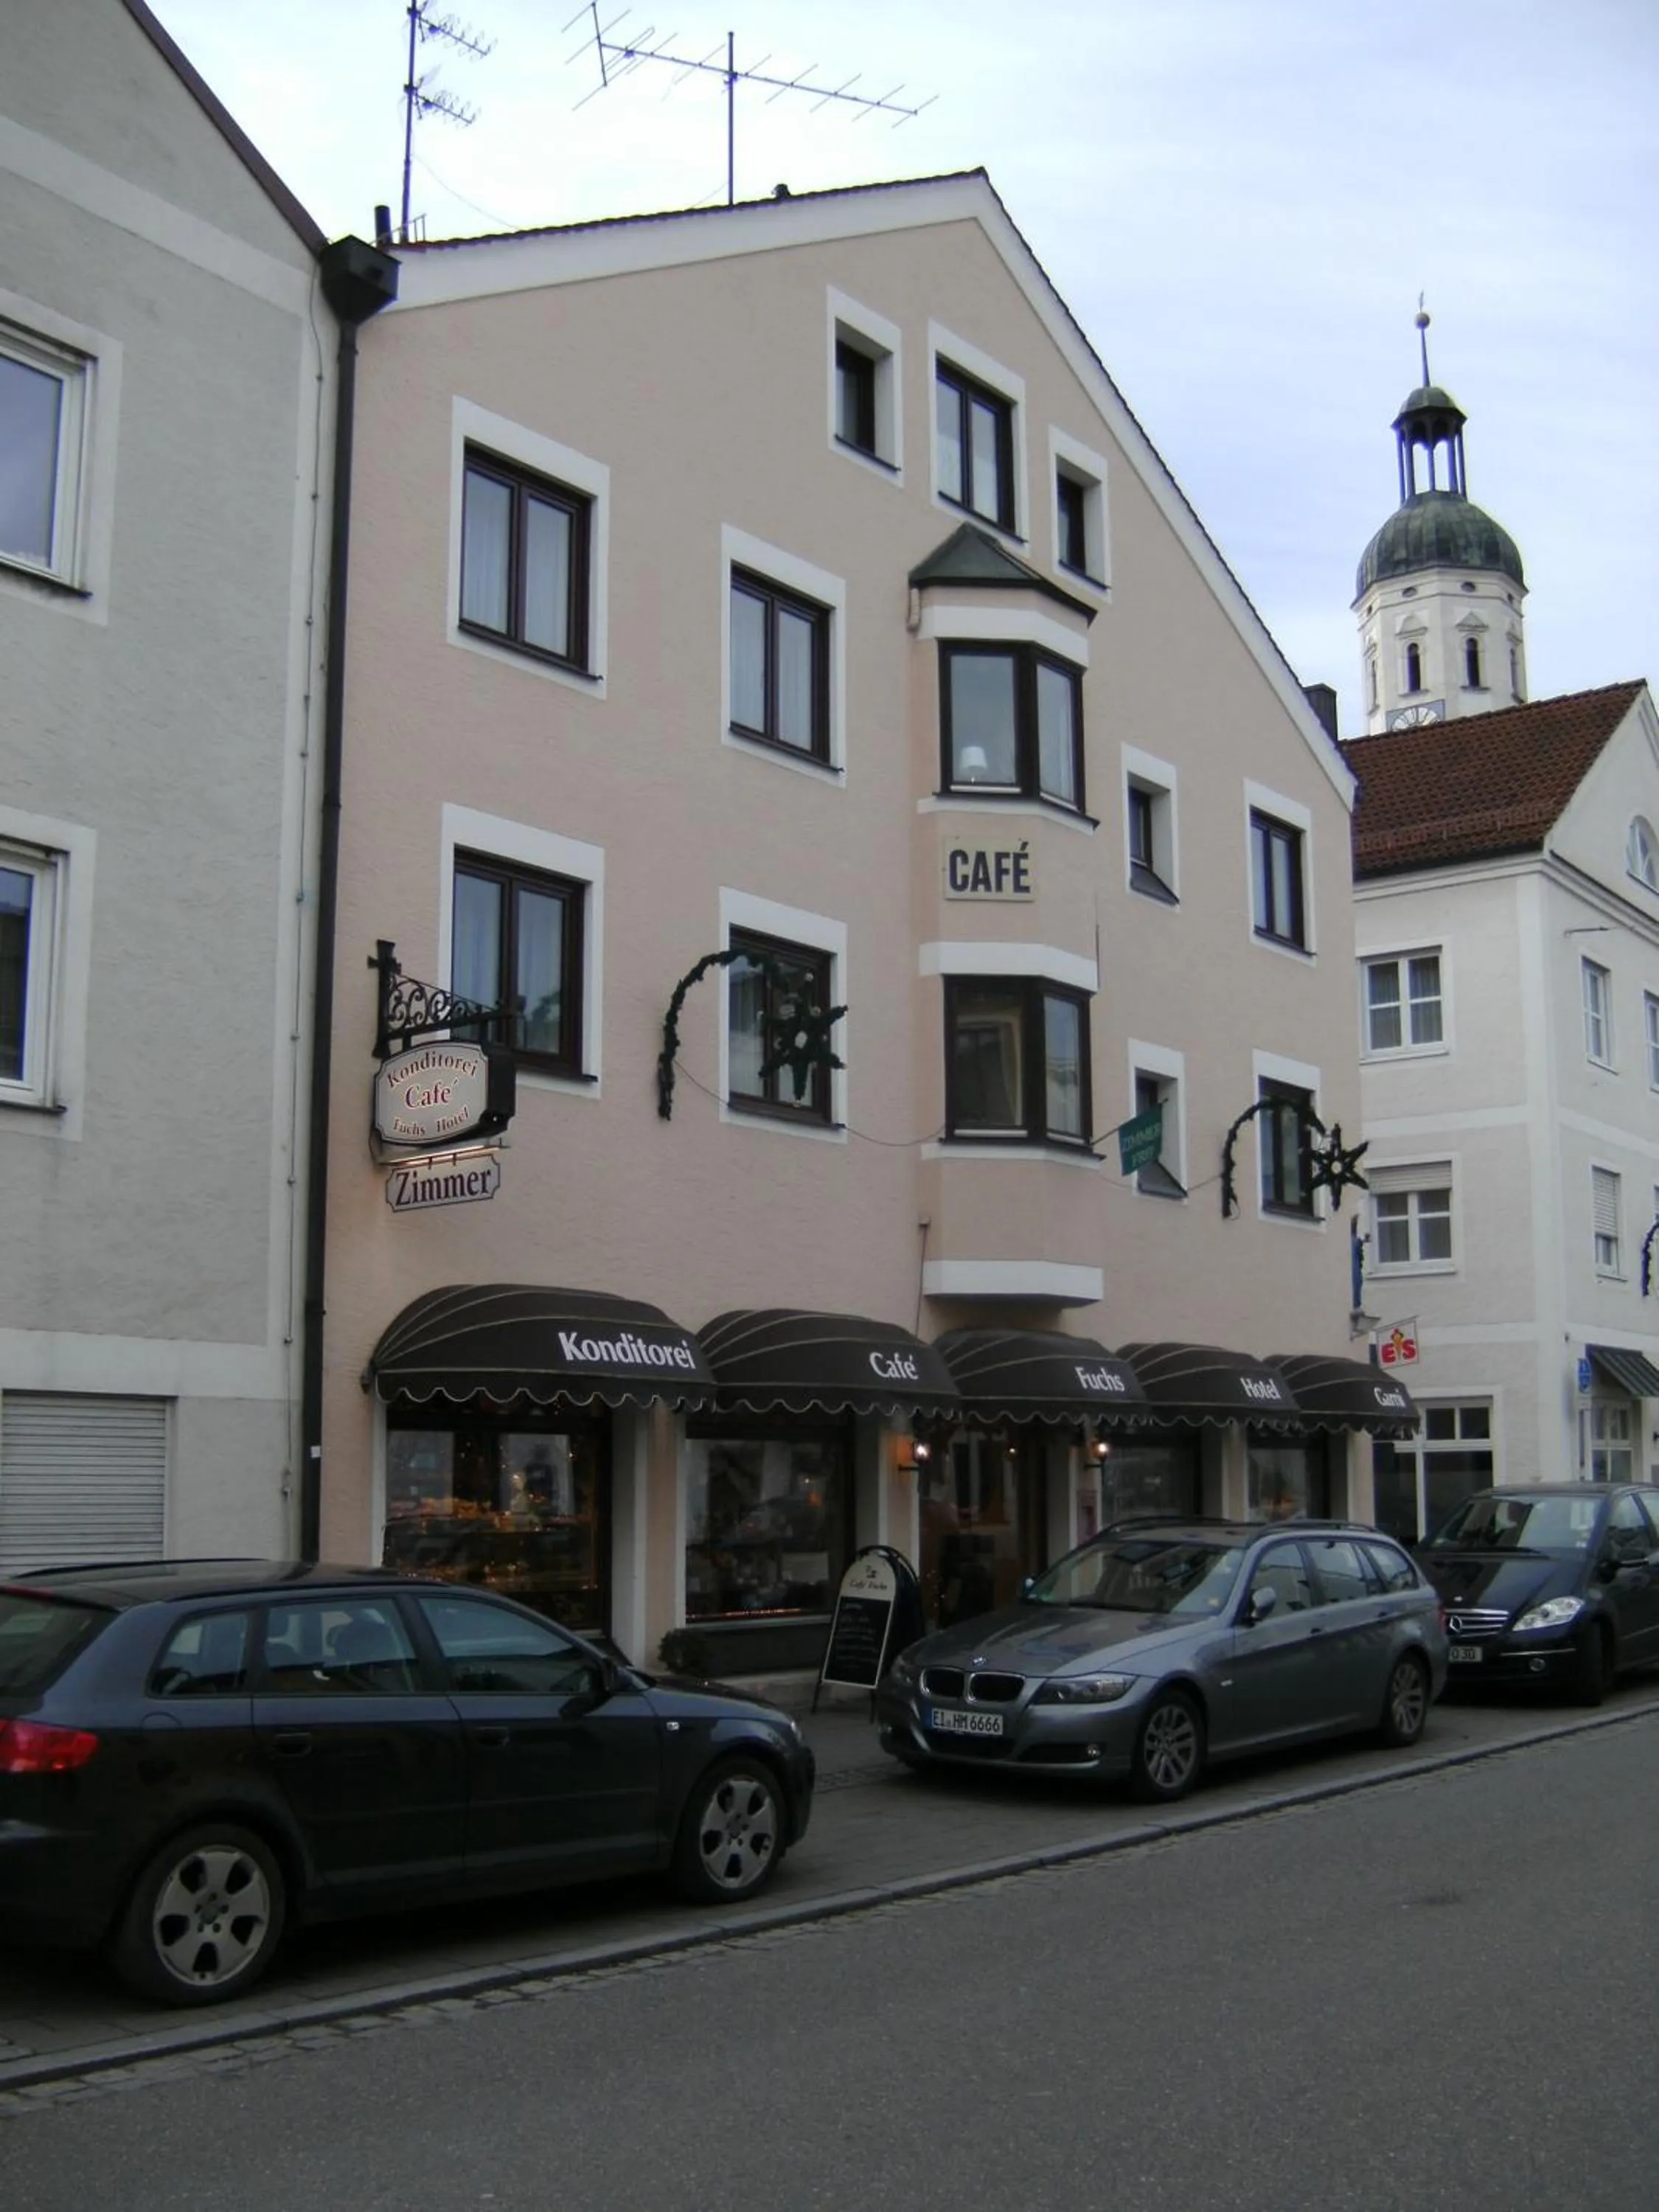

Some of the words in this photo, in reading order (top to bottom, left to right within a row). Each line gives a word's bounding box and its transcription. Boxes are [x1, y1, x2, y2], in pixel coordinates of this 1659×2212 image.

[949, 841, 1031, 894] CAFÉ
[386, 1051, 479, 1088] Konditorei
[405, 1079, 459, 1108] Café
[393, 1117, 425, 1136] Fuchs
[436, 1106, 469, 1133] Hotel
[395, 1168, 492, 1207] Zimmer
[557, 1332, 696, 1370] Konditorei
[869, 1351, 919, 1381] Café
[1074, 1366, 1126, 1393] Fuchs
[1239, 1377, 1281, 1401] Hotel
